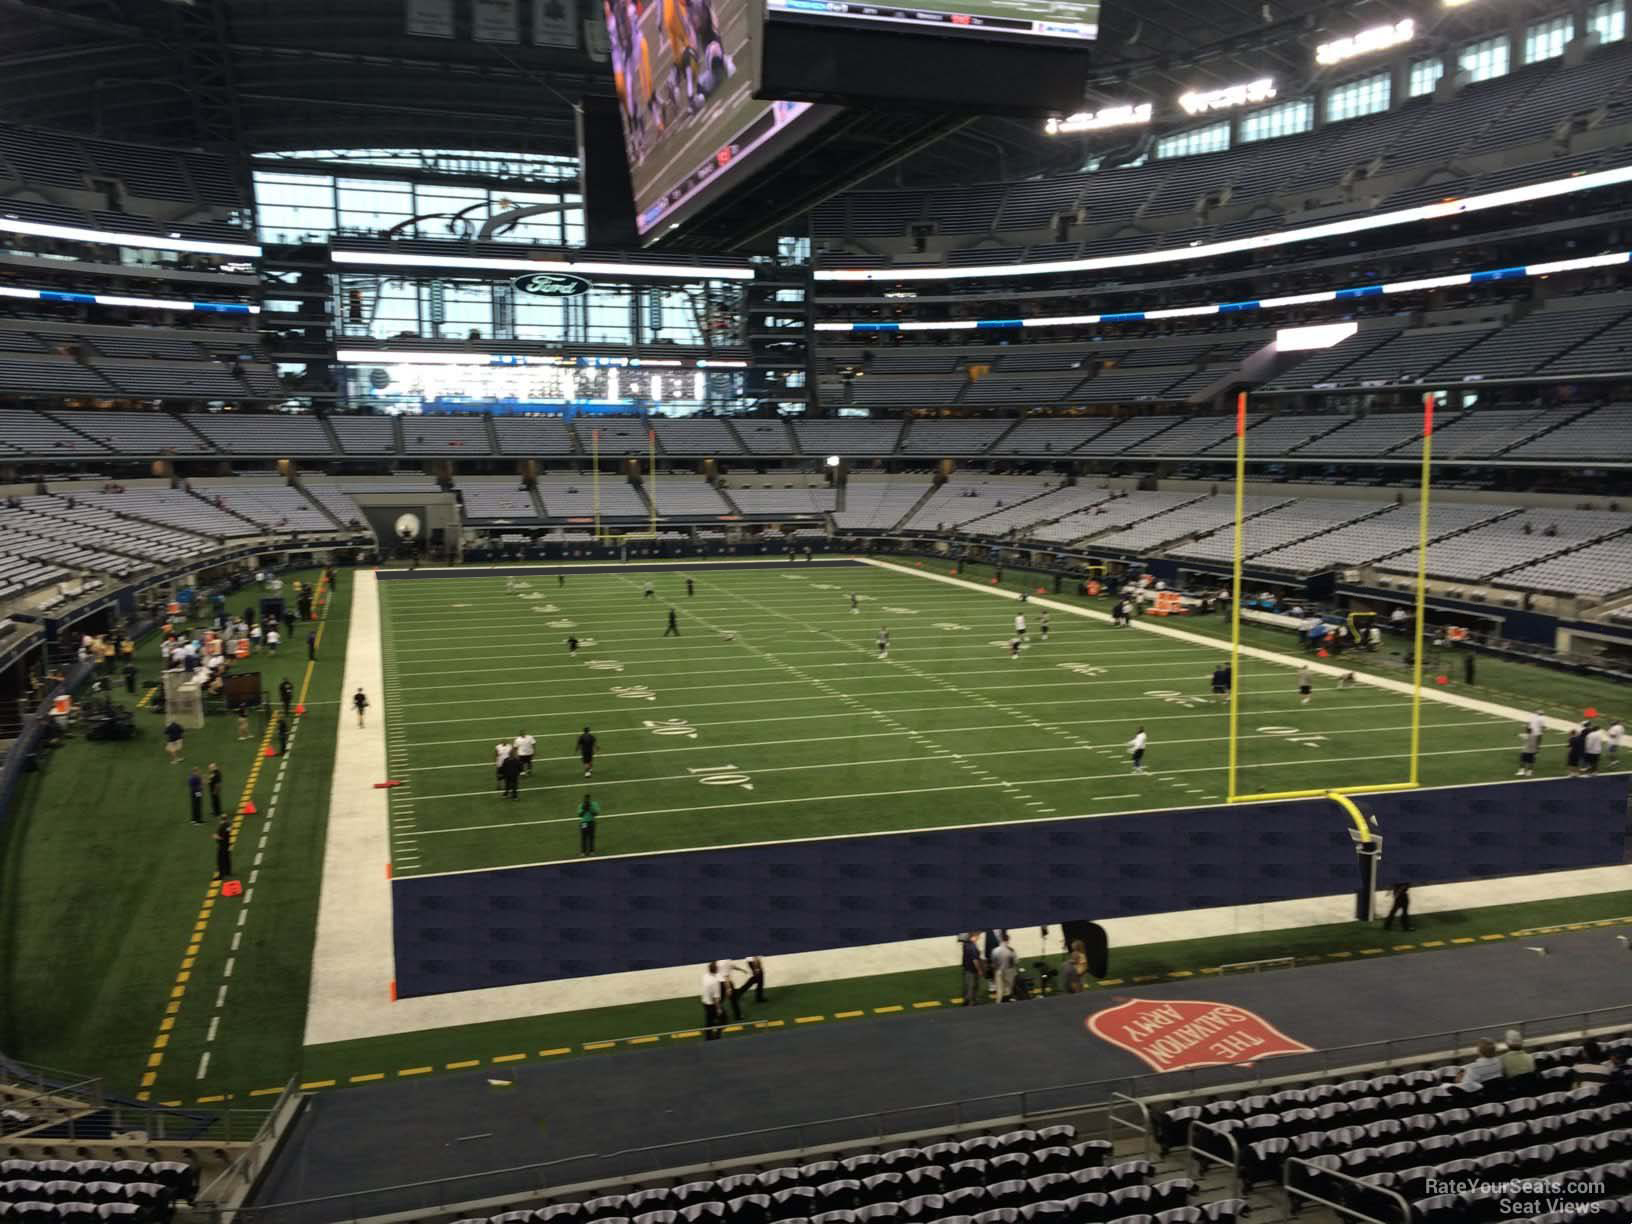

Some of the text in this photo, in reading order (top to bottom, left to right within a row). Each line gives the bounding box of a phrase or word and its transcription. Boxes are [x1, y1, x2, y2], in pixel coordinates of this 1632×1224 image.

[526, 275, 577, 293] Ford
[687, 764, 751, 785] 10
[1123, 1004, 1184, 1042] ARMY
[1142, 1006, 1248, 1064] SALVATION
[1209, 1031, 1264, 1059] THE
